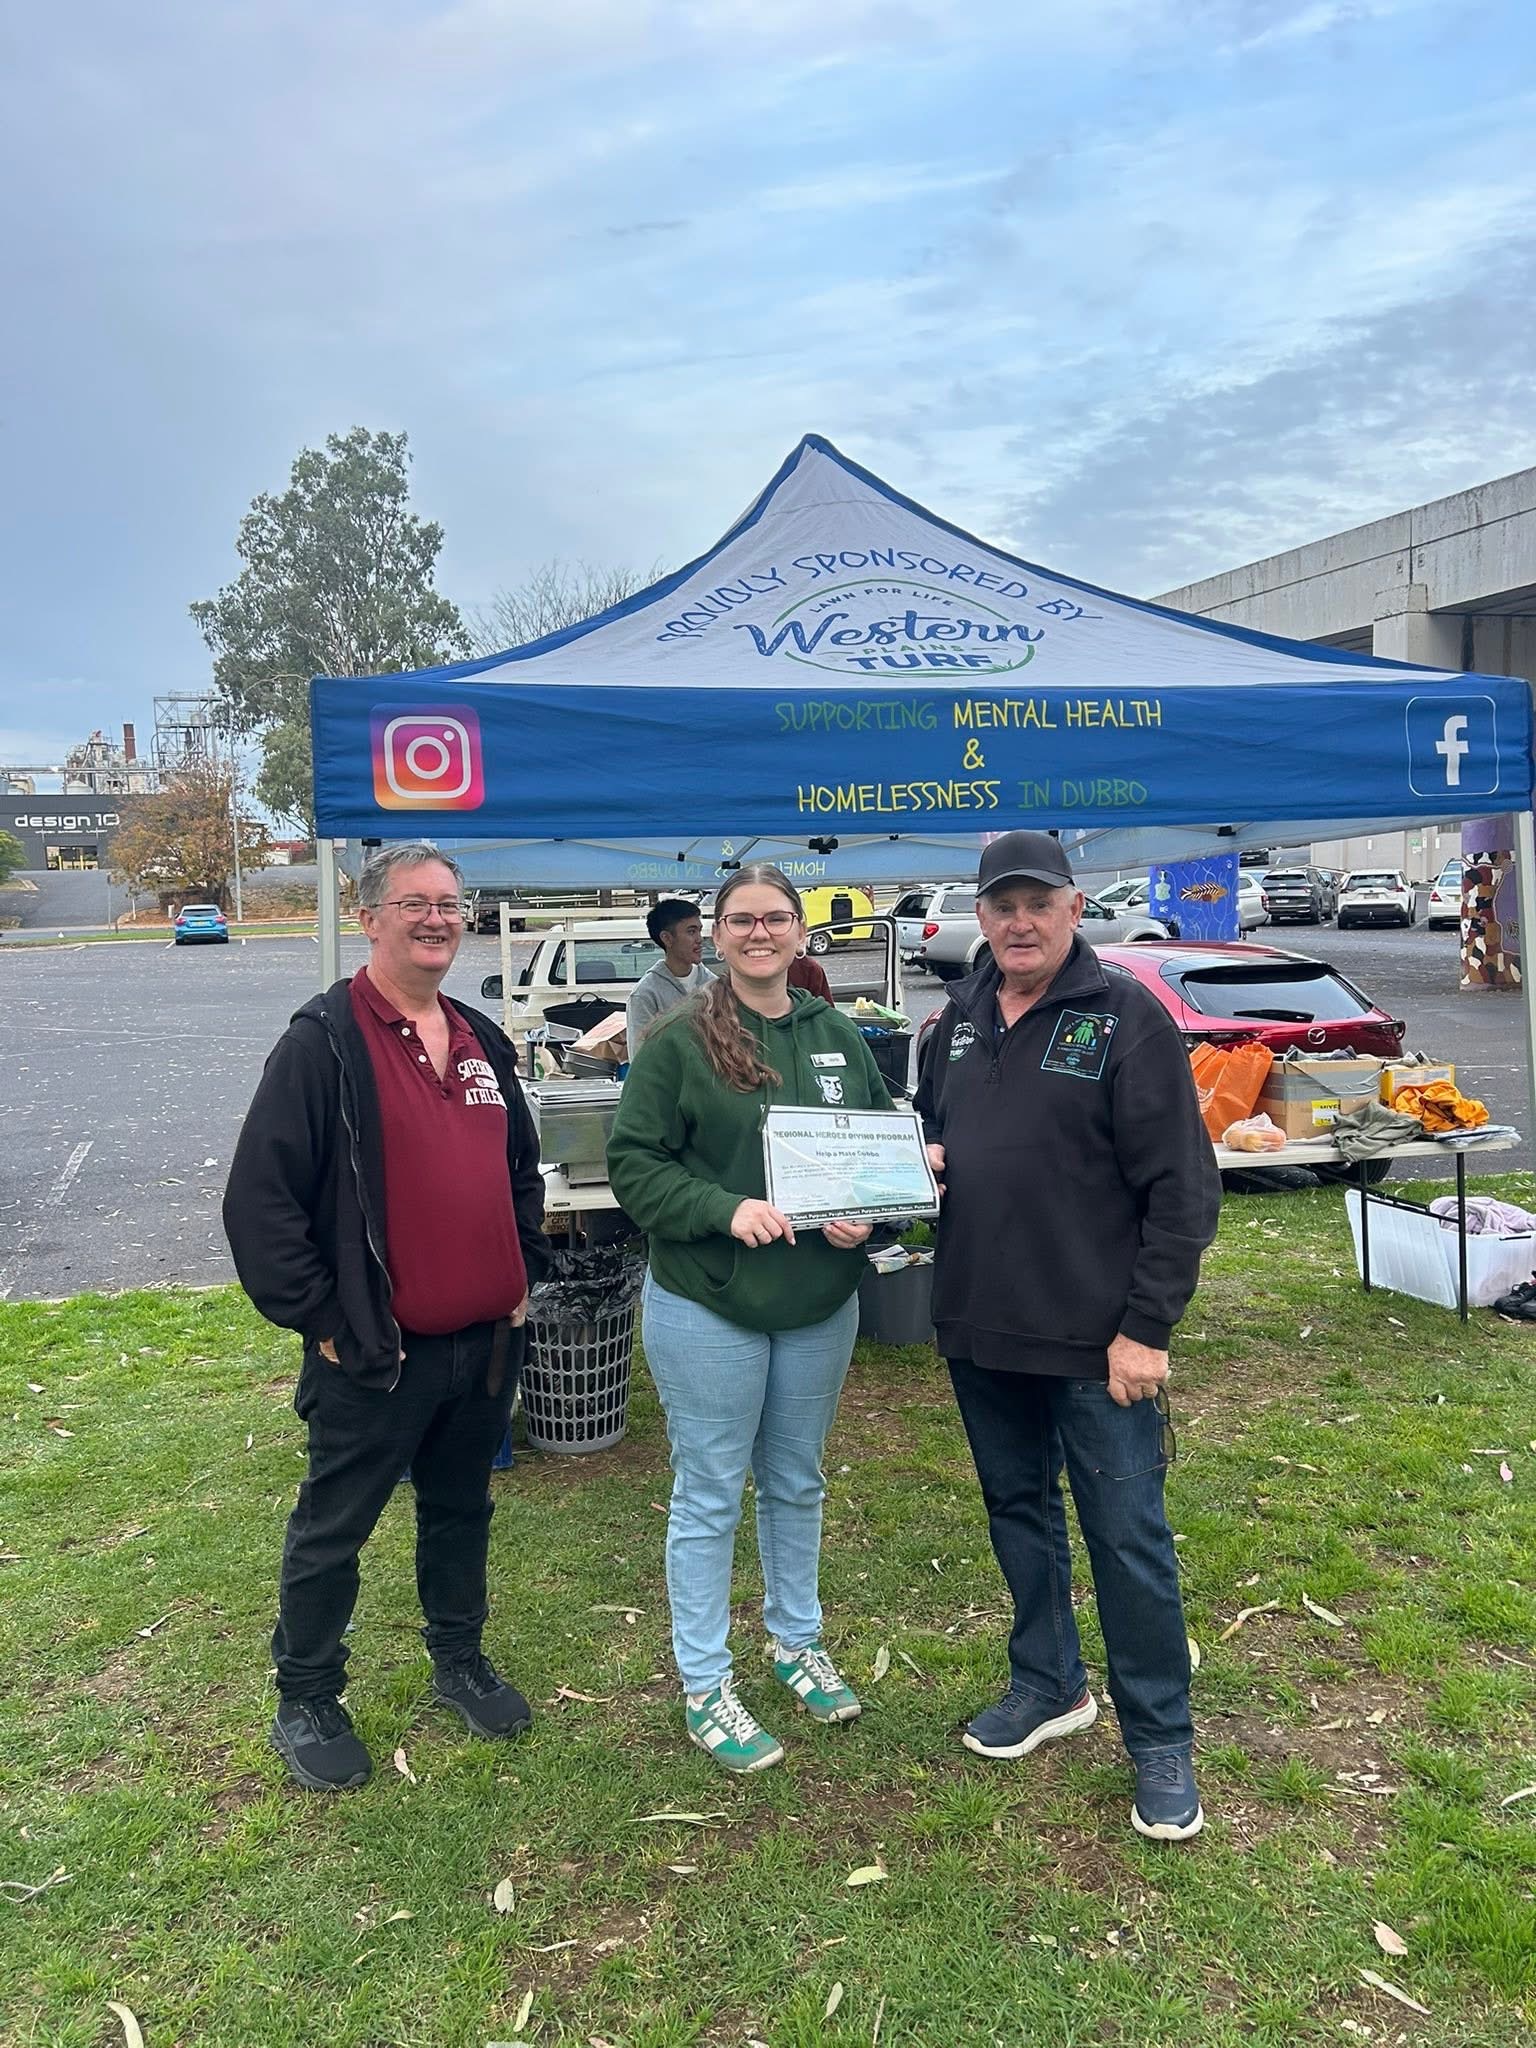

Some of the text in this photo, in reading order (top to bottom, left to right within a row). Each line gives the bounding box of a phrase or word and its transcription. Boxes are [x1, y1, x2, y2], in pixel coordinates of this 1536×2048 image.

[656, 548, 1104, 642] PROUDLY SPONSORED BY
[809, 592, 856, 613] LAWN
[912, 591, 954, 606] LIFE
[733, 610, 1045, 656] Western
[846, 653, 993, 670] TURF
[863, 645, 963, 655] PLAINS
[775, 698, 1162, 732] SUPPORTING MENTAL HEALTH
[962, 738, 985, 770] &
[797, 778, 1148, 813] HOMELESSNESS IN DUBBO
[14, 813, 120, 830] design 10
[465, 1087, 508, 1110] ATHLE
